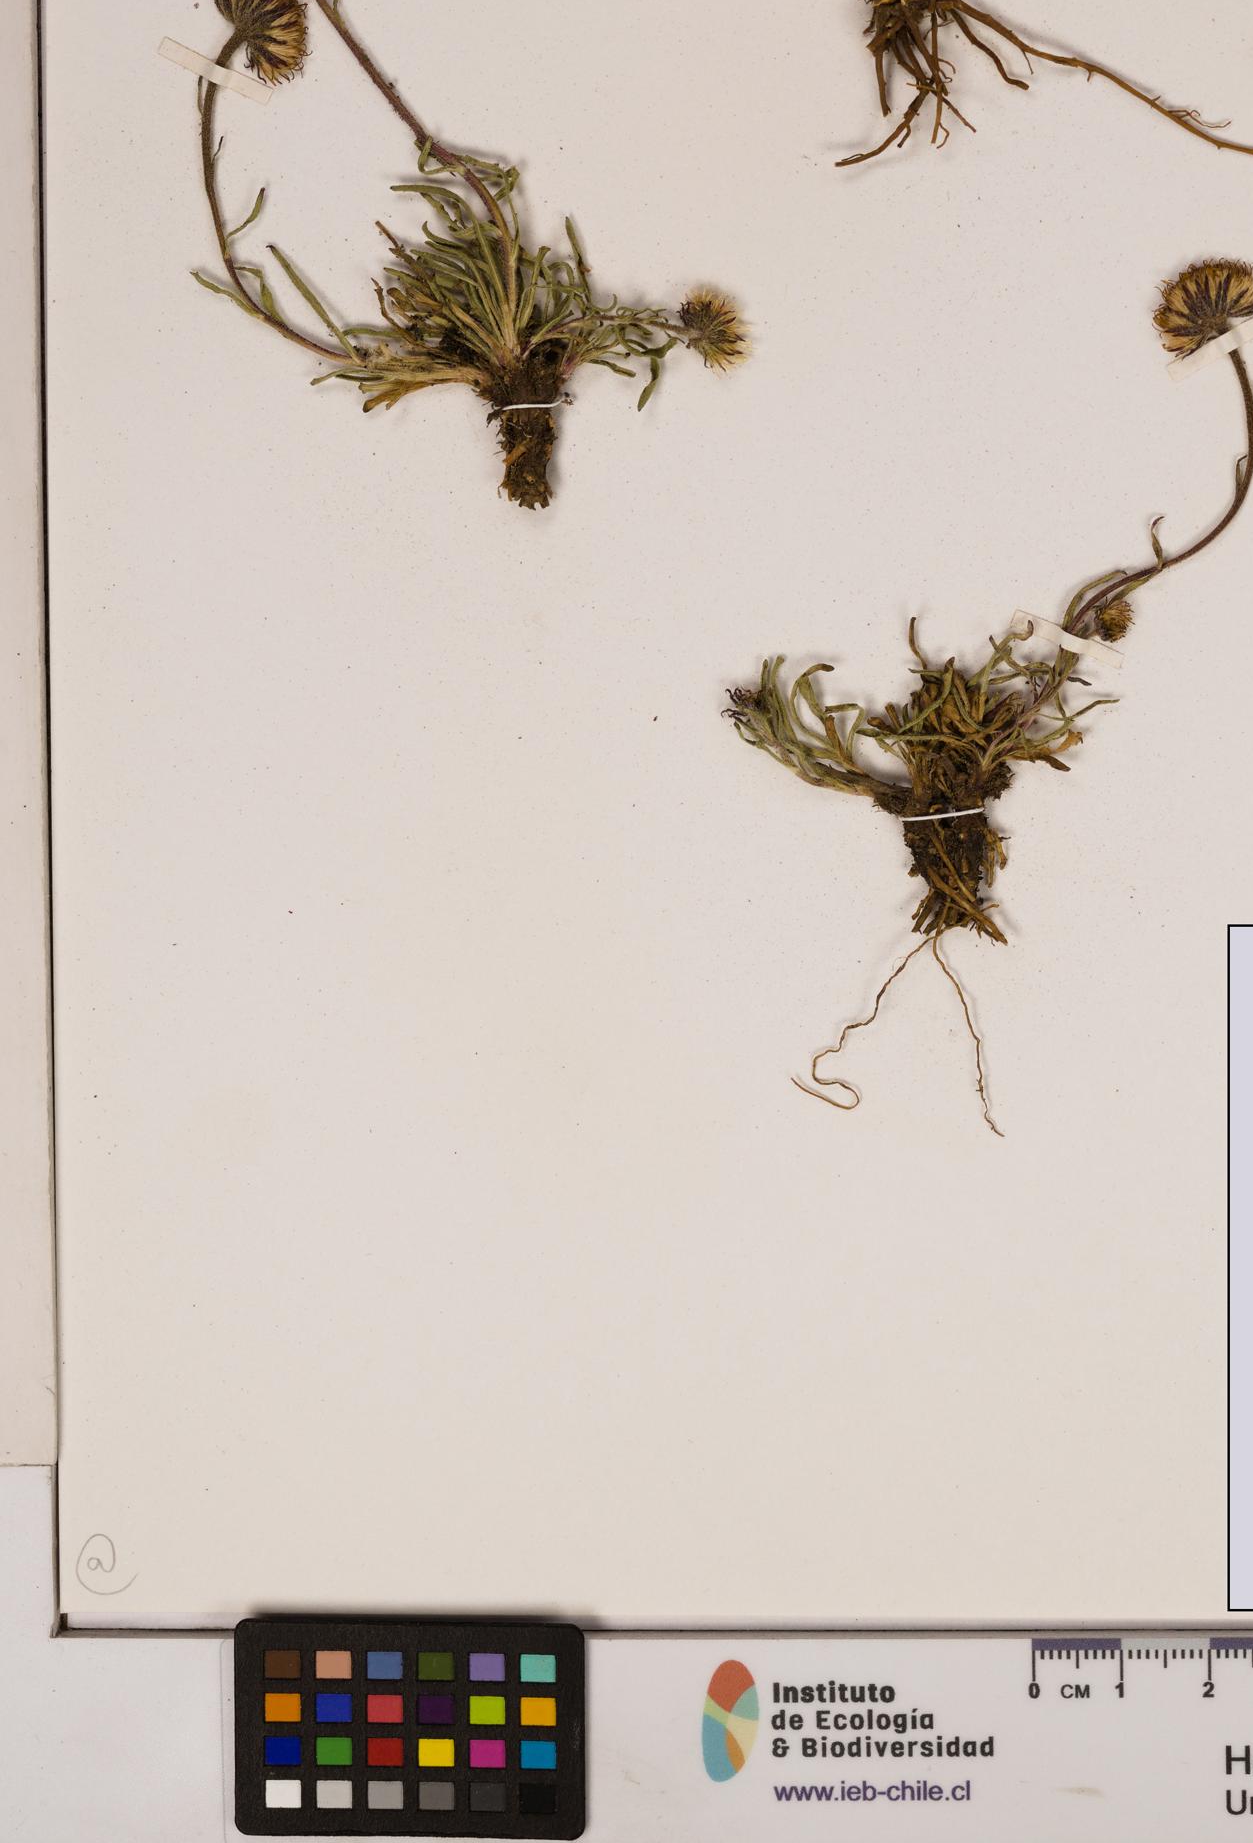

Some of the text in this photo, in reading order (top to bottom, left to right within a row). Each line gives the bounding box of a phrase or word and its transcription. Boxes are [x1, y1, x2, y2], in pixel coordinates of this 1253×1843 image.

[772, 1679, 897, 1704] Instituto
[1028, 1682, 1041, 1699] 0
[1060, 1684, 1091, 1700] CM
[1114, 1682, 1126, 1699] 1
[1201, 1681, 1216, 1699] 2
[770, 1707, 935, 1734] de Ecología
[771, 1735, 995, 1759] & Biodiversidad
[772, 1779, 971, 1802] www.ieb-chile.cl
